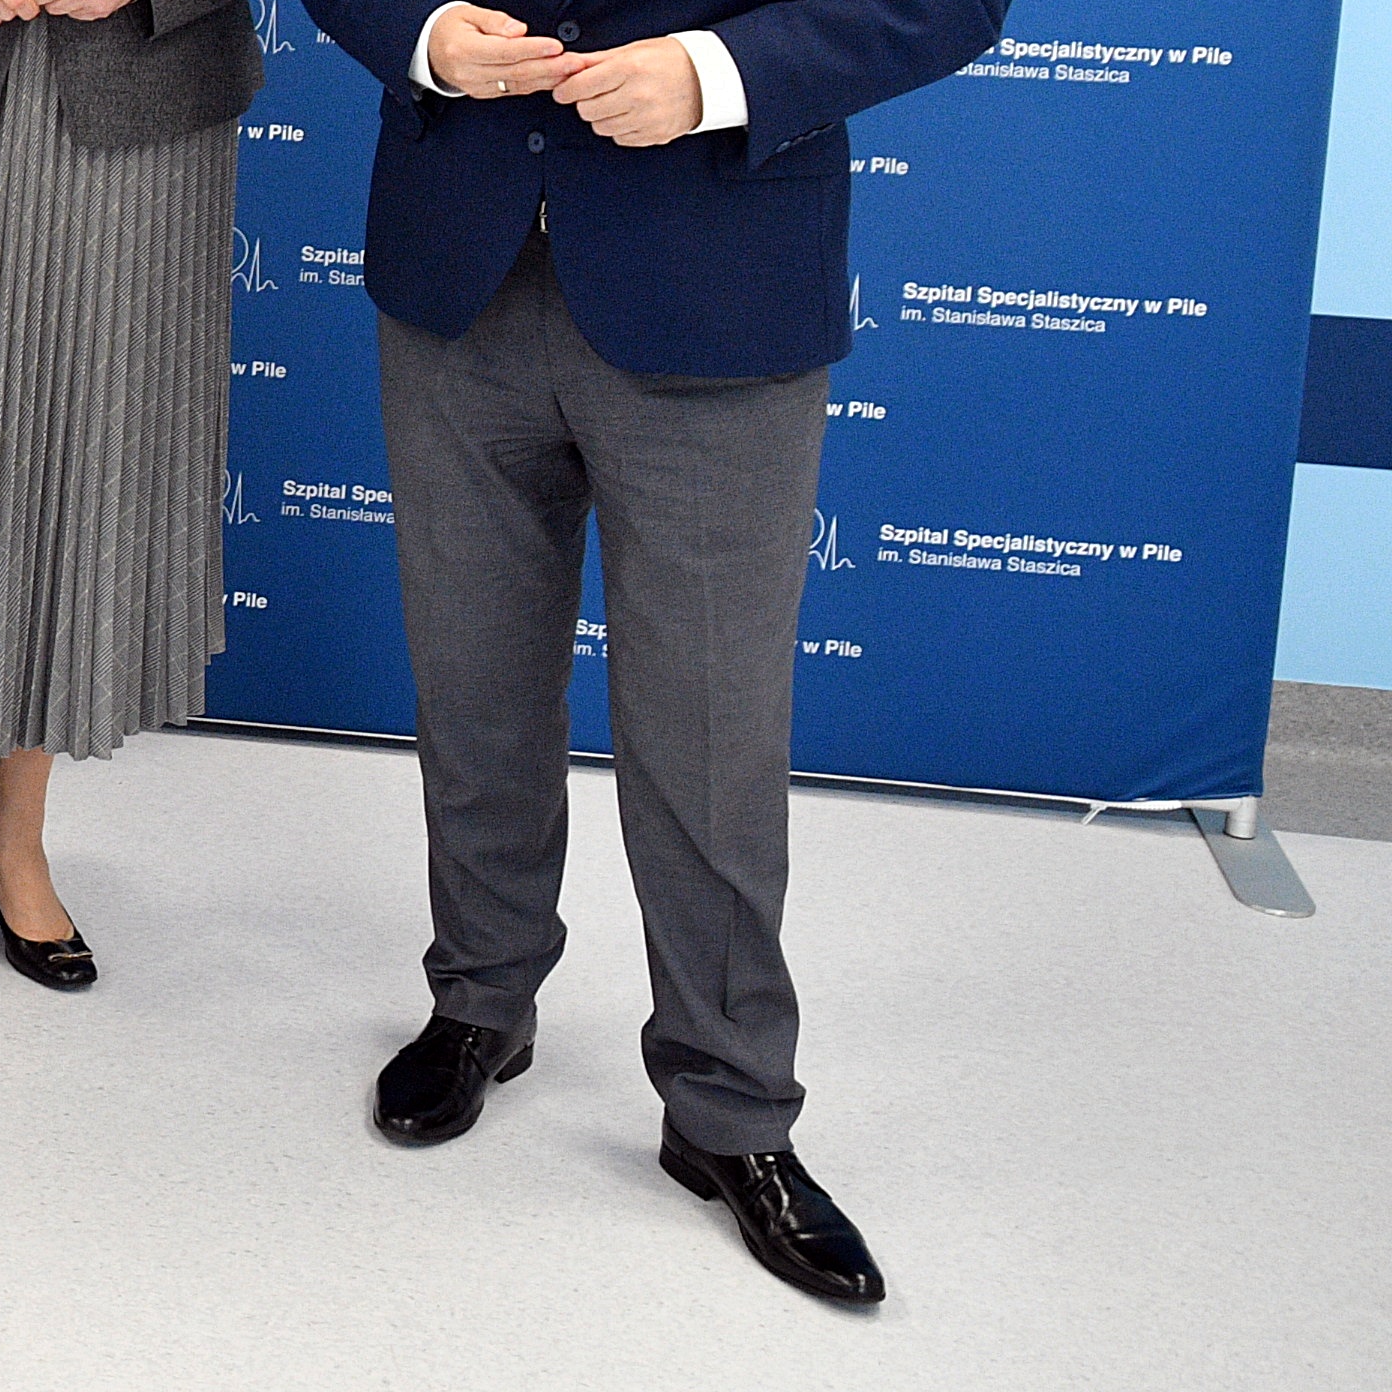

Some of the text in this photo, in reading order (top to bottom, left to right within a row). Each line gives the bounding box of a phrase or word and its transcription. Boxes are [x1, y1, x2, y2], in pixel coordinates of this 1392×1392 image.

[999, 37, 1233, 67] Specjalistyczny Pile
[1054, 64, 1130, 84] Staszica
[268, 124, 305, 142] Pile
[849, 156, 909, 176] w Pile
[301, 245, 366, 267] Szpital
[902, 281, 1208, 317] Szpital Specjalistyczny w Pile
[932, 306, 1106, 333] Stanisława Staszica
[251, 360, 287, 379] Pile
[825, 401, 887, 420] w Pile
[283, 479, 347, 501] Szpital
[879, 523, 1183, 563] Szpital Specjalistyczny w Pile
[908, 548, 1081, 577] Stanisława Staszica
[232, 591, 268, 609] Pile
[824, 639, 863, 658] Pile
